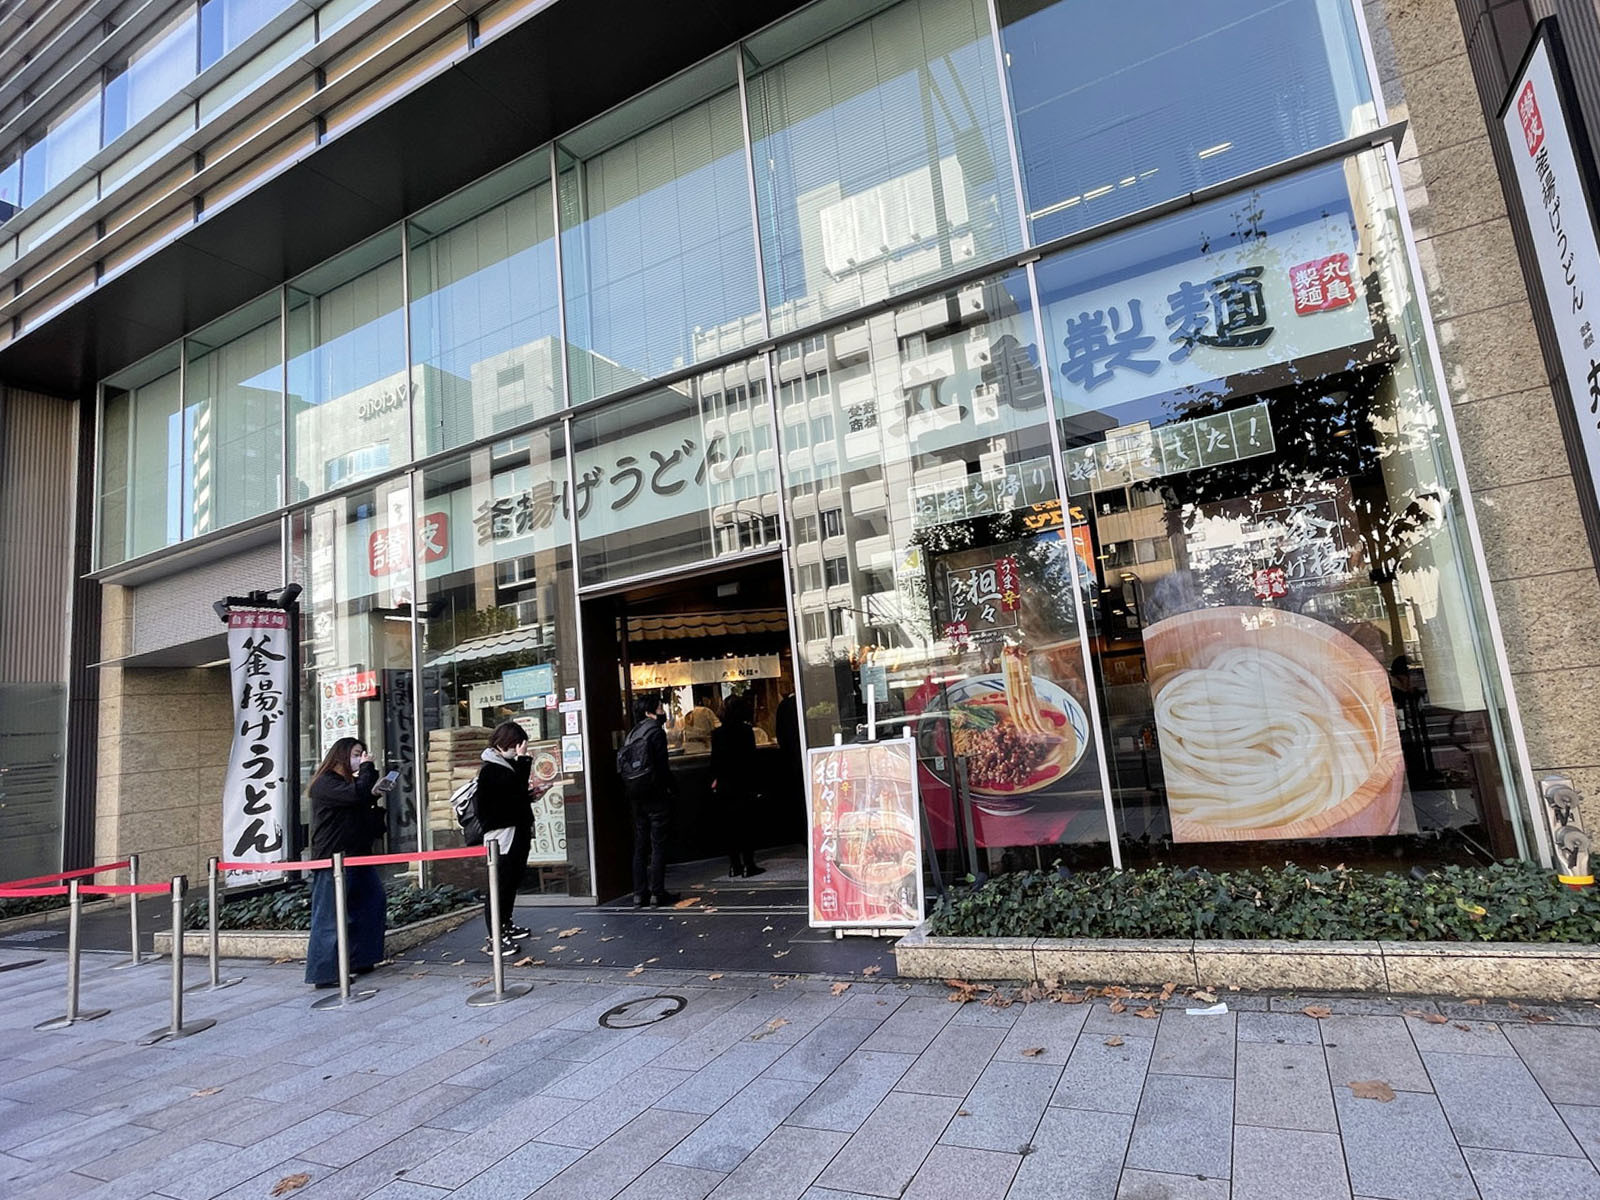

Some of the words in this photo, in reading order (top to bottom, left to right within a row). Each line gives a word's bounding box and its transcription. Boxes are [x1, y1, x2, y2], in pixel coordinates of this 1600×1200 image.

[1001, 559, 1020, 609] うま辛
[232, 634, 286, 857] 釜揚げうどん
